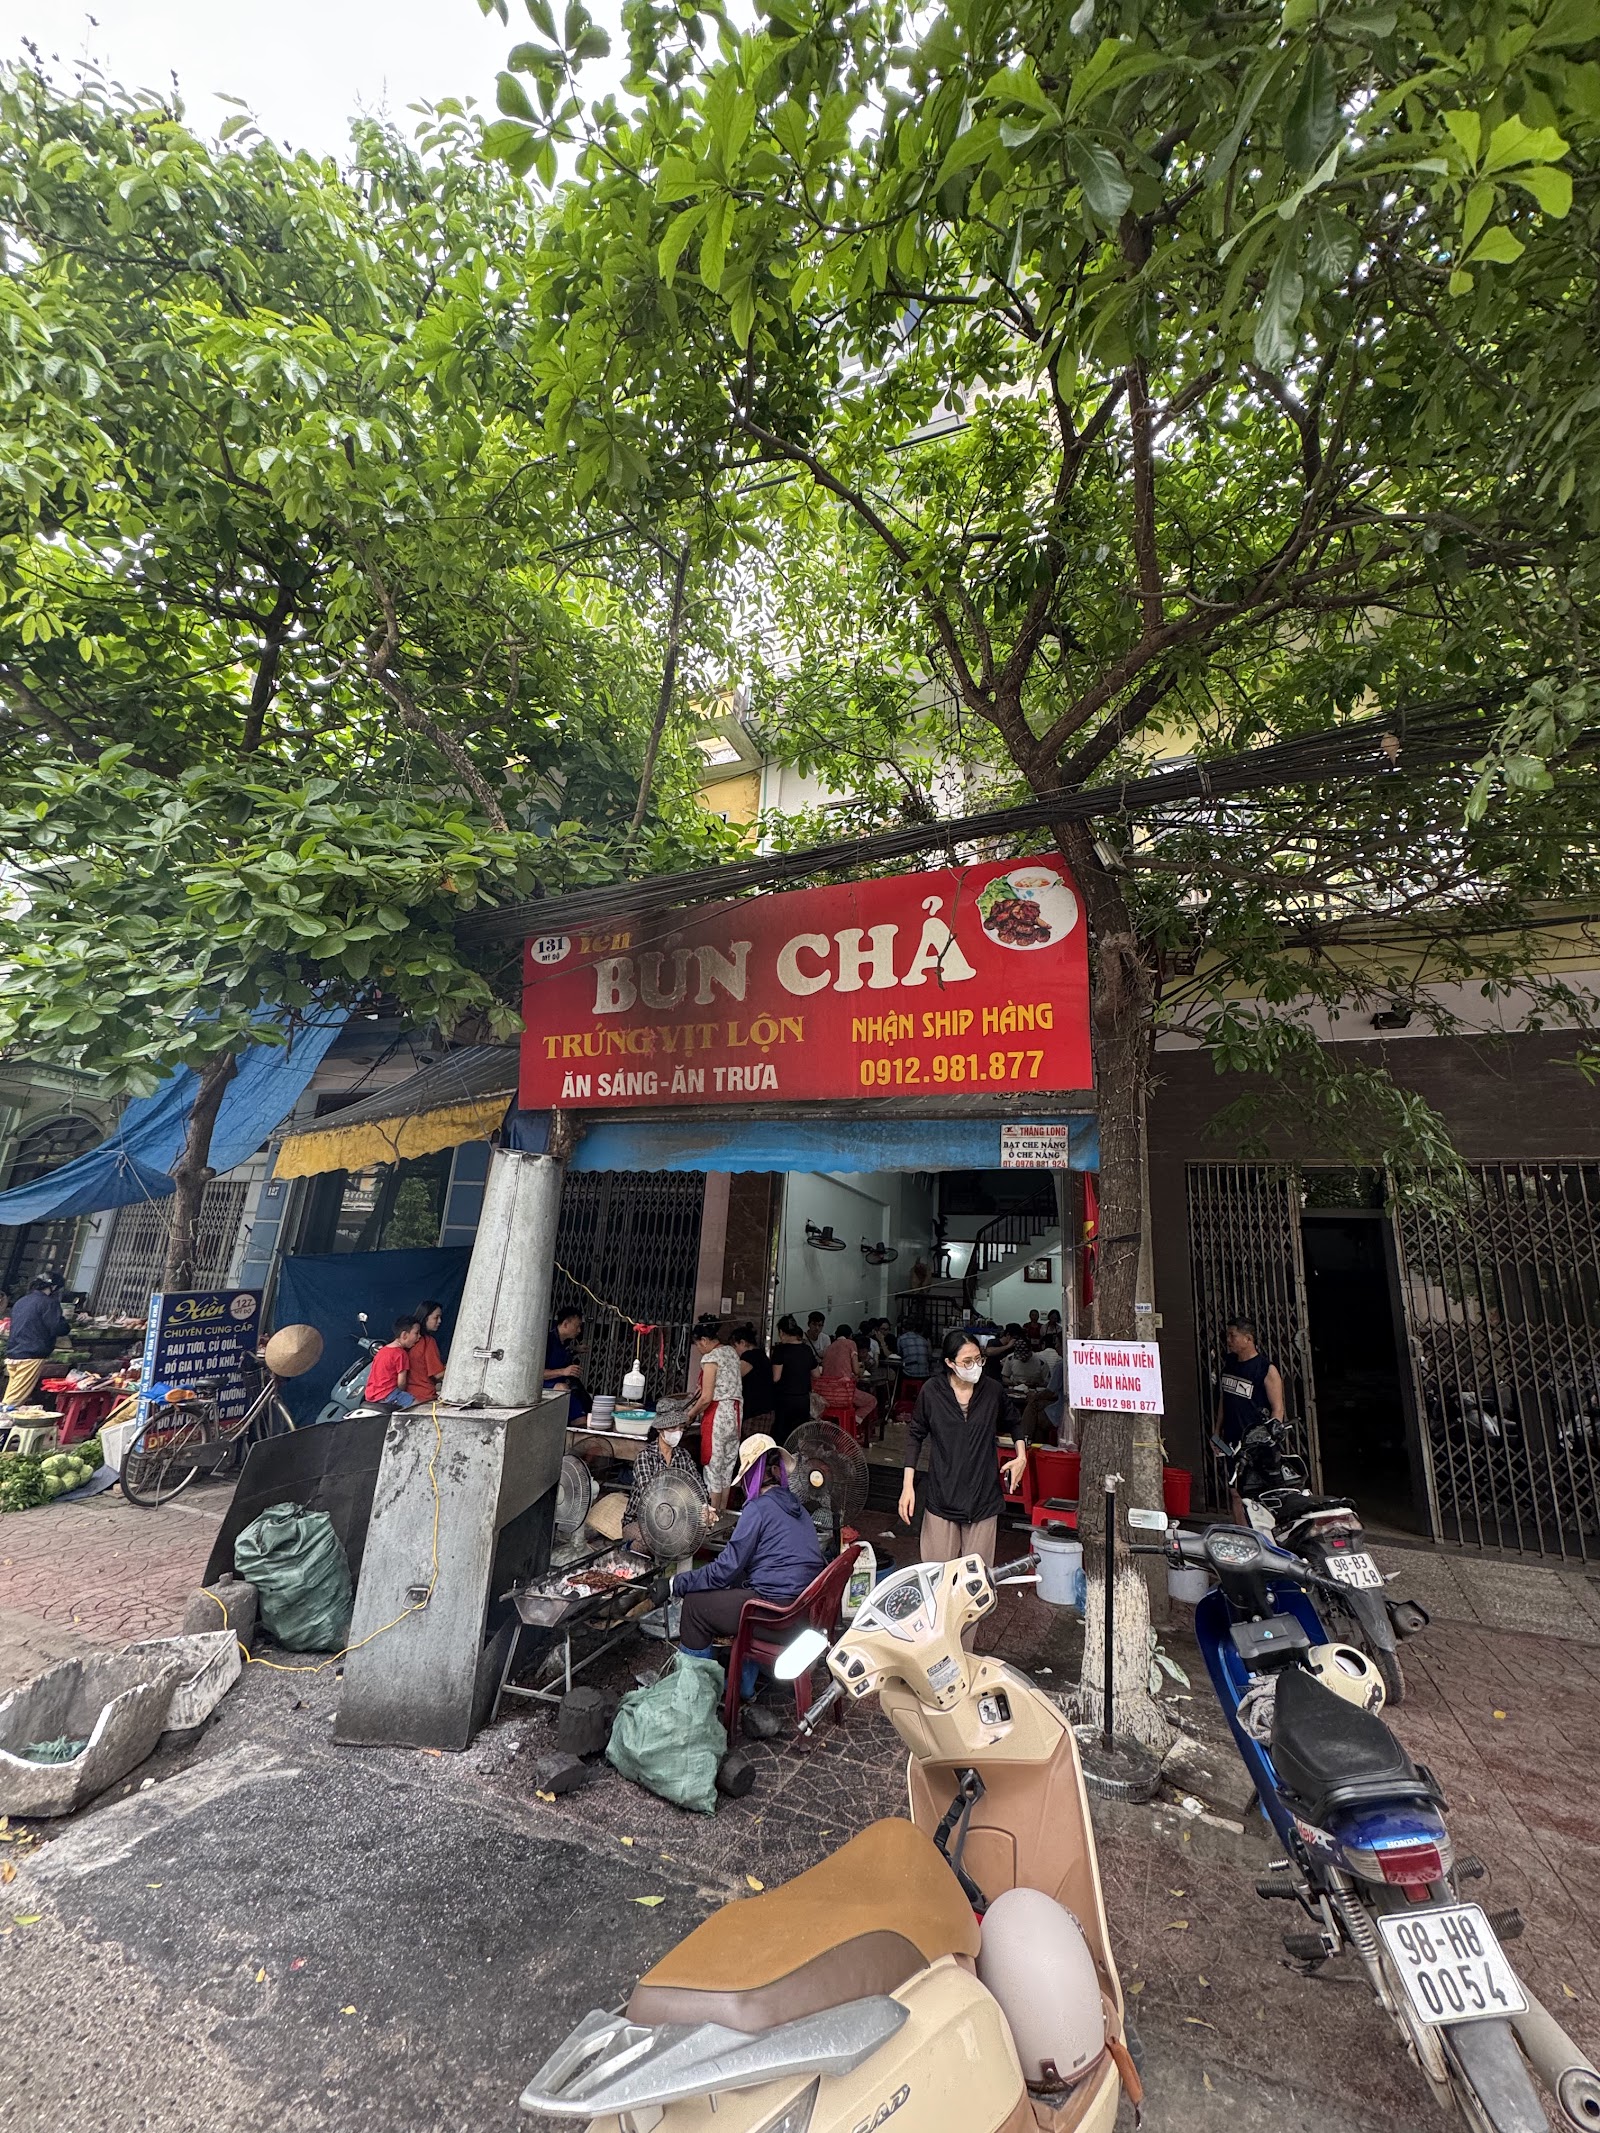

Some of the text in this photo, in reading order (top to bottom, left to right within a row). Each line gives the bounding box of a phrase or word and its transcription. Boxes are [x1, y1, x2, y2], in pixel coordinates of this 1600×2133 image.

[538, 937, 564, 954] 131
[776, 895, 977, 996] CHẢ
[851, 1000, 1054, 1047] NHẬN SHIP HÀNG
[542, 1012, 805, 1060] TRỨNG VỊT LỘN
[859, 1049, 1045, 1087] 0912.981.877
[561, 1070, 591, 1099] ĂN
[712, 1062, 779, 1091] TRƯA
[1046, 1126, 1067, 1137] LONG
[1016, 1151, 1034, 1159] CHE
[1021, 1141, 1039, 1149] CHE
[168, 1295, 226, 1323] Hiền
[236, 1298, 253, 1308] 127
[163, 1321, 255, 1339] CHUYÊN CUNG CẤP:
[166, 1343, 185, 1357] RAU
[208, 1335, 220, 1351] CỦ
[178, 1360, 193, 1372] GIA
[1072, 1345, 1155, 1369] TUYỂN NHÂN VIÊN
[1093, 1372, 1142, 1392] BÁN HÀNG
[1080, 1396, 1157, 1412] LH: 0912 981 877
[1333, 1555, 1368, 1572] 98-B3
[1386, 1836, 1422, 1849] HONDA
[1396, 1914, 1485, 1966] 98-H8
[1417, 1961, 1509, 2015] 0054
